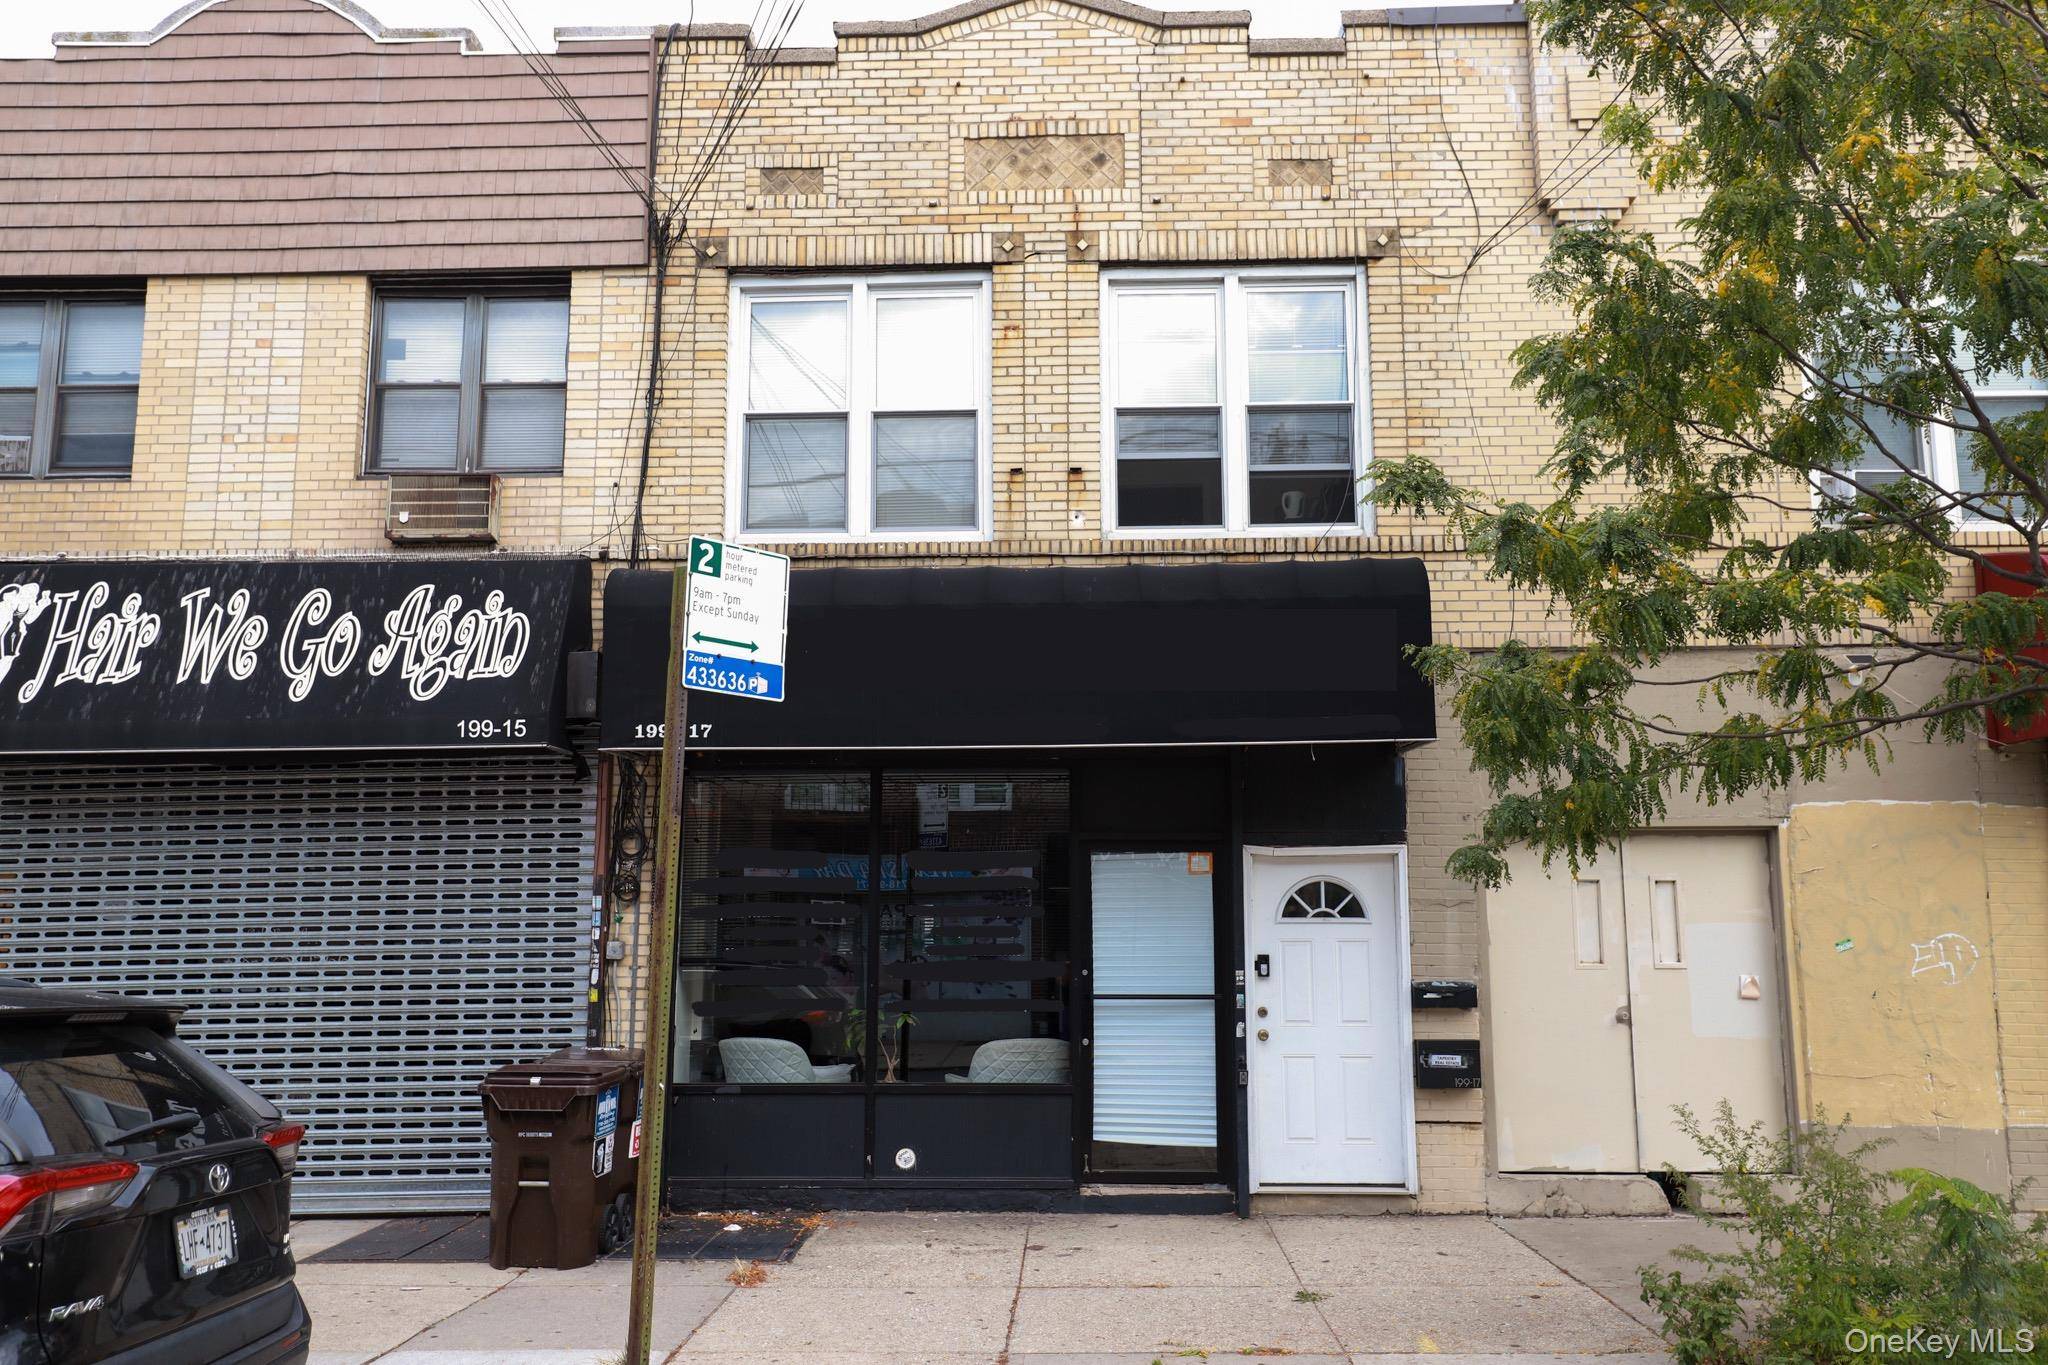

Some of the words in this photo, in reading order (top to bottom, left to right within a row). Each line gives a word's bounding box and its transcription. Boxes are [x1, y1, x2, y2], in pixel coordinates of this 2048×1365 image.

[698, 542, 714, 574] 2
[726, 550, 743, 561] hour
[725, 562, 758, 576] metered
[725, 573, 753, 587] parking
[693, 586, 713, 600] 9am
[723, 592, 741, 605] 7pm
[692, 600, 724, 617] Except
[727, 607, 760, 625] Sunday
[18, 581, 161, 703] Hair
[176, 587, 268, 685] We
[280, 588, 361, 702] Go
[368, 584, 531, 702] Again
[688, 653, 714, 665] Zone#
[687, 665, 746, 692] 433636
[456, 719, 527, 739] 199-15
[49, 1295, 105, 1323] RAV4
